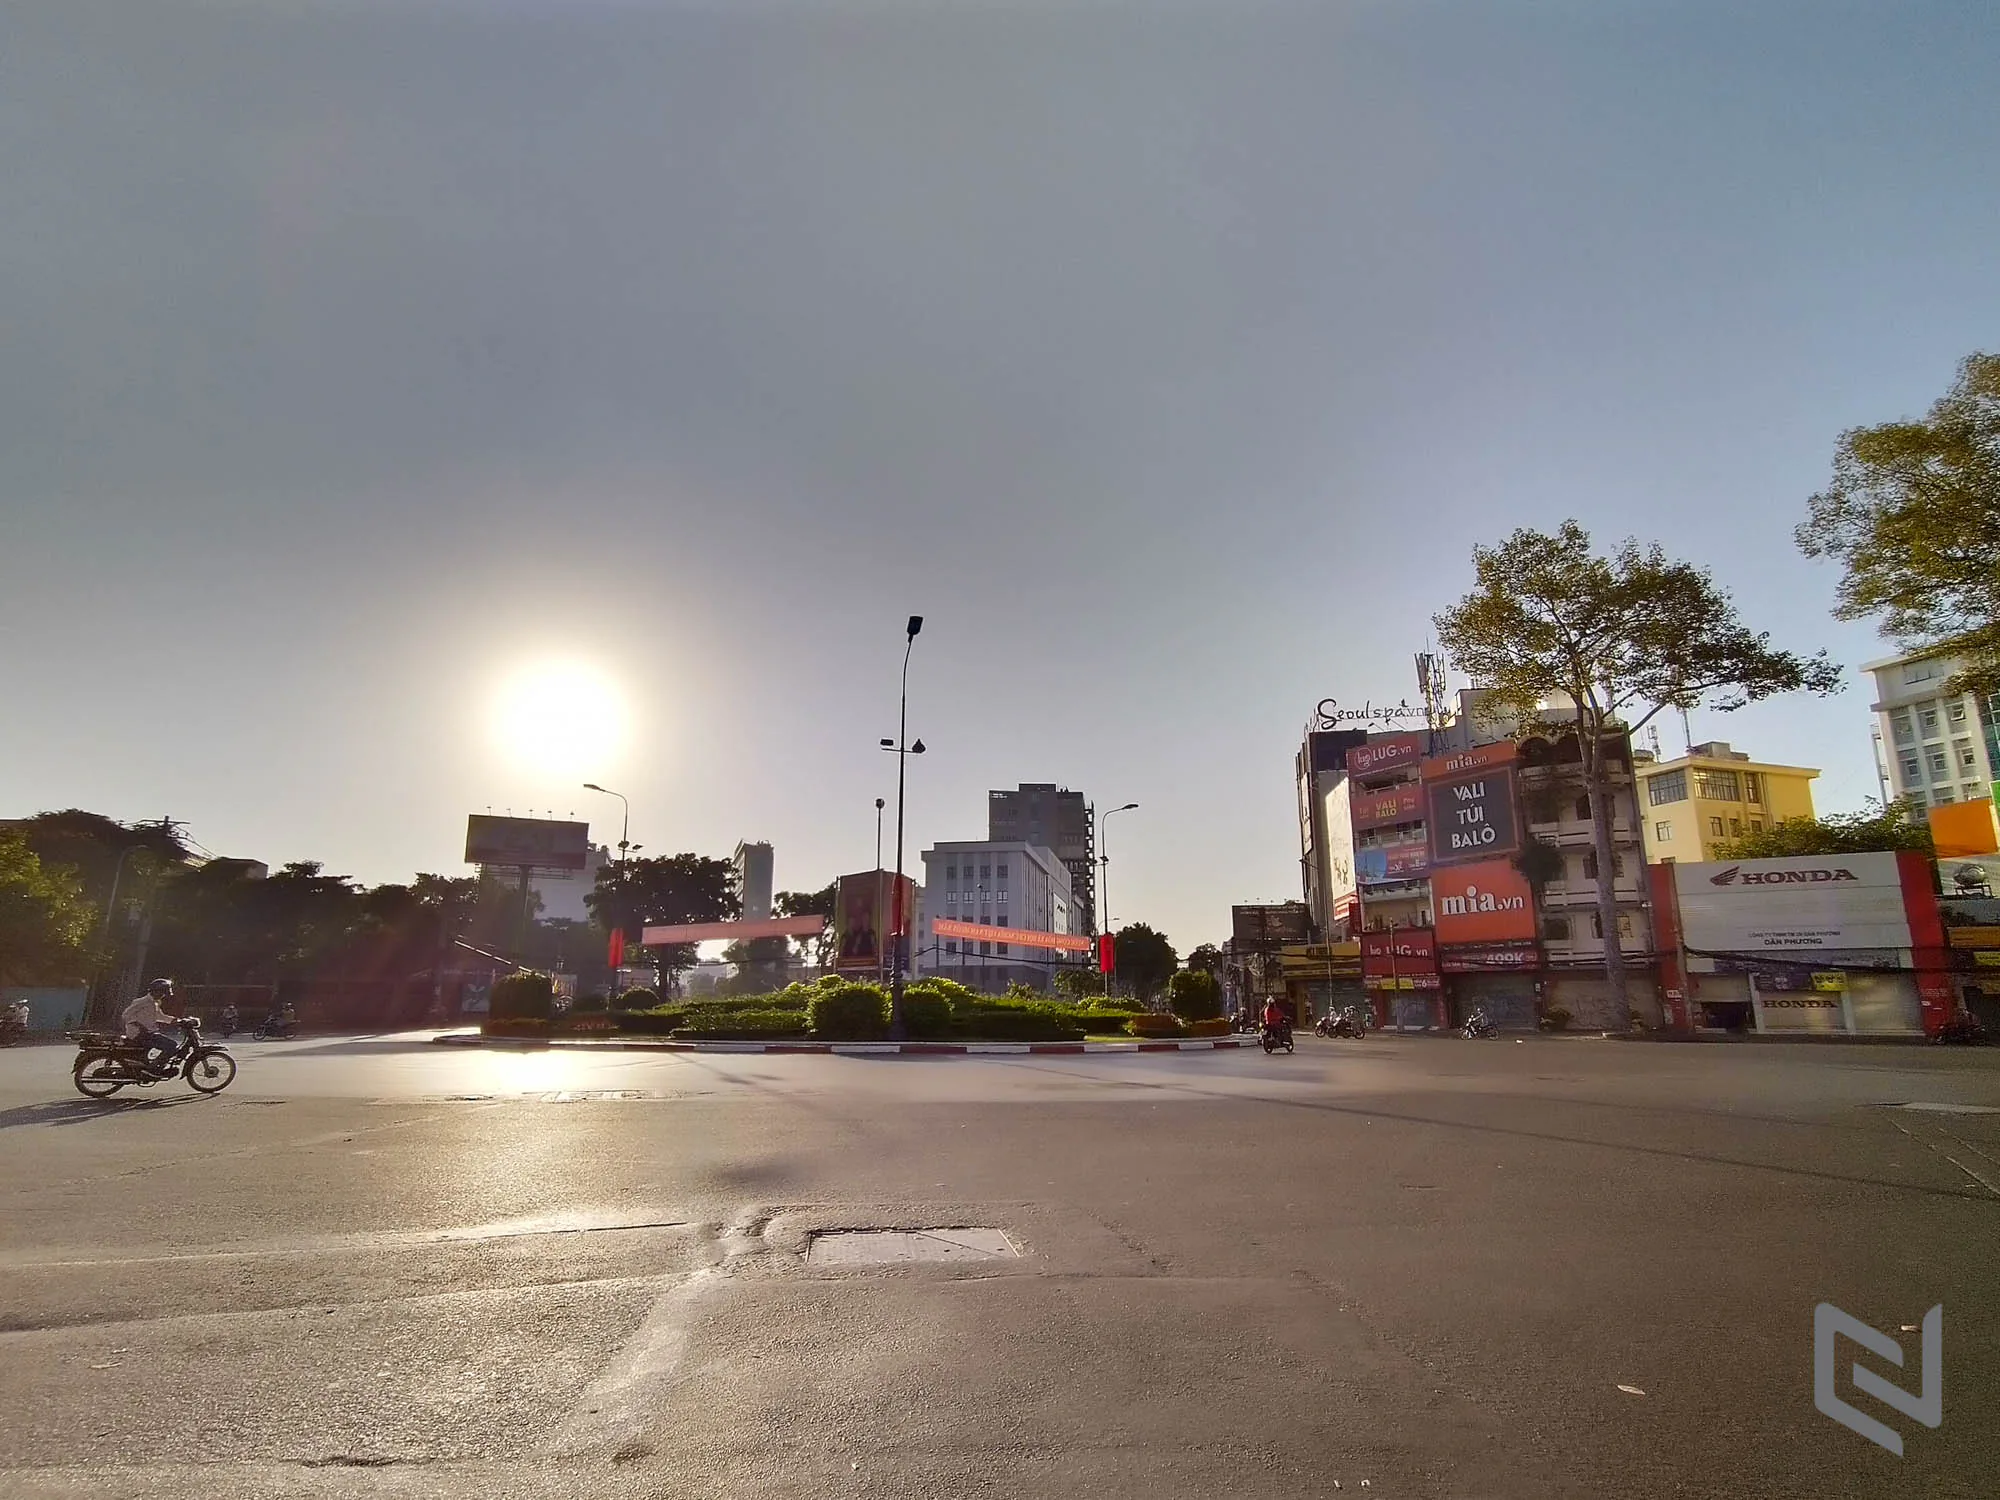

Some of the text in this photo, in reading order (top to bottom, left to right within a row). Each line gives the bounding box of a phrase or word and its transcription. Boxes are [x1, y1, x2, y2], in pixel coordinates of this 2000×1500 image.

[1372, 744, 1412, 761] LUG.vn
[1446, 754, 1487, 770] mia.vn
[1453, 782, 1485, 800] VALI
[1375, 799, 1397, 809] VALI
[1456, 803, 1484, 824] TÚI
[1451, 823, 1496, 848] BALÔ
[1741, 869, 1858, 885] HONDA
[1441, 886, 1524, 915] mia.vn
[1763, 1000, 1838, 1008] HONDA
